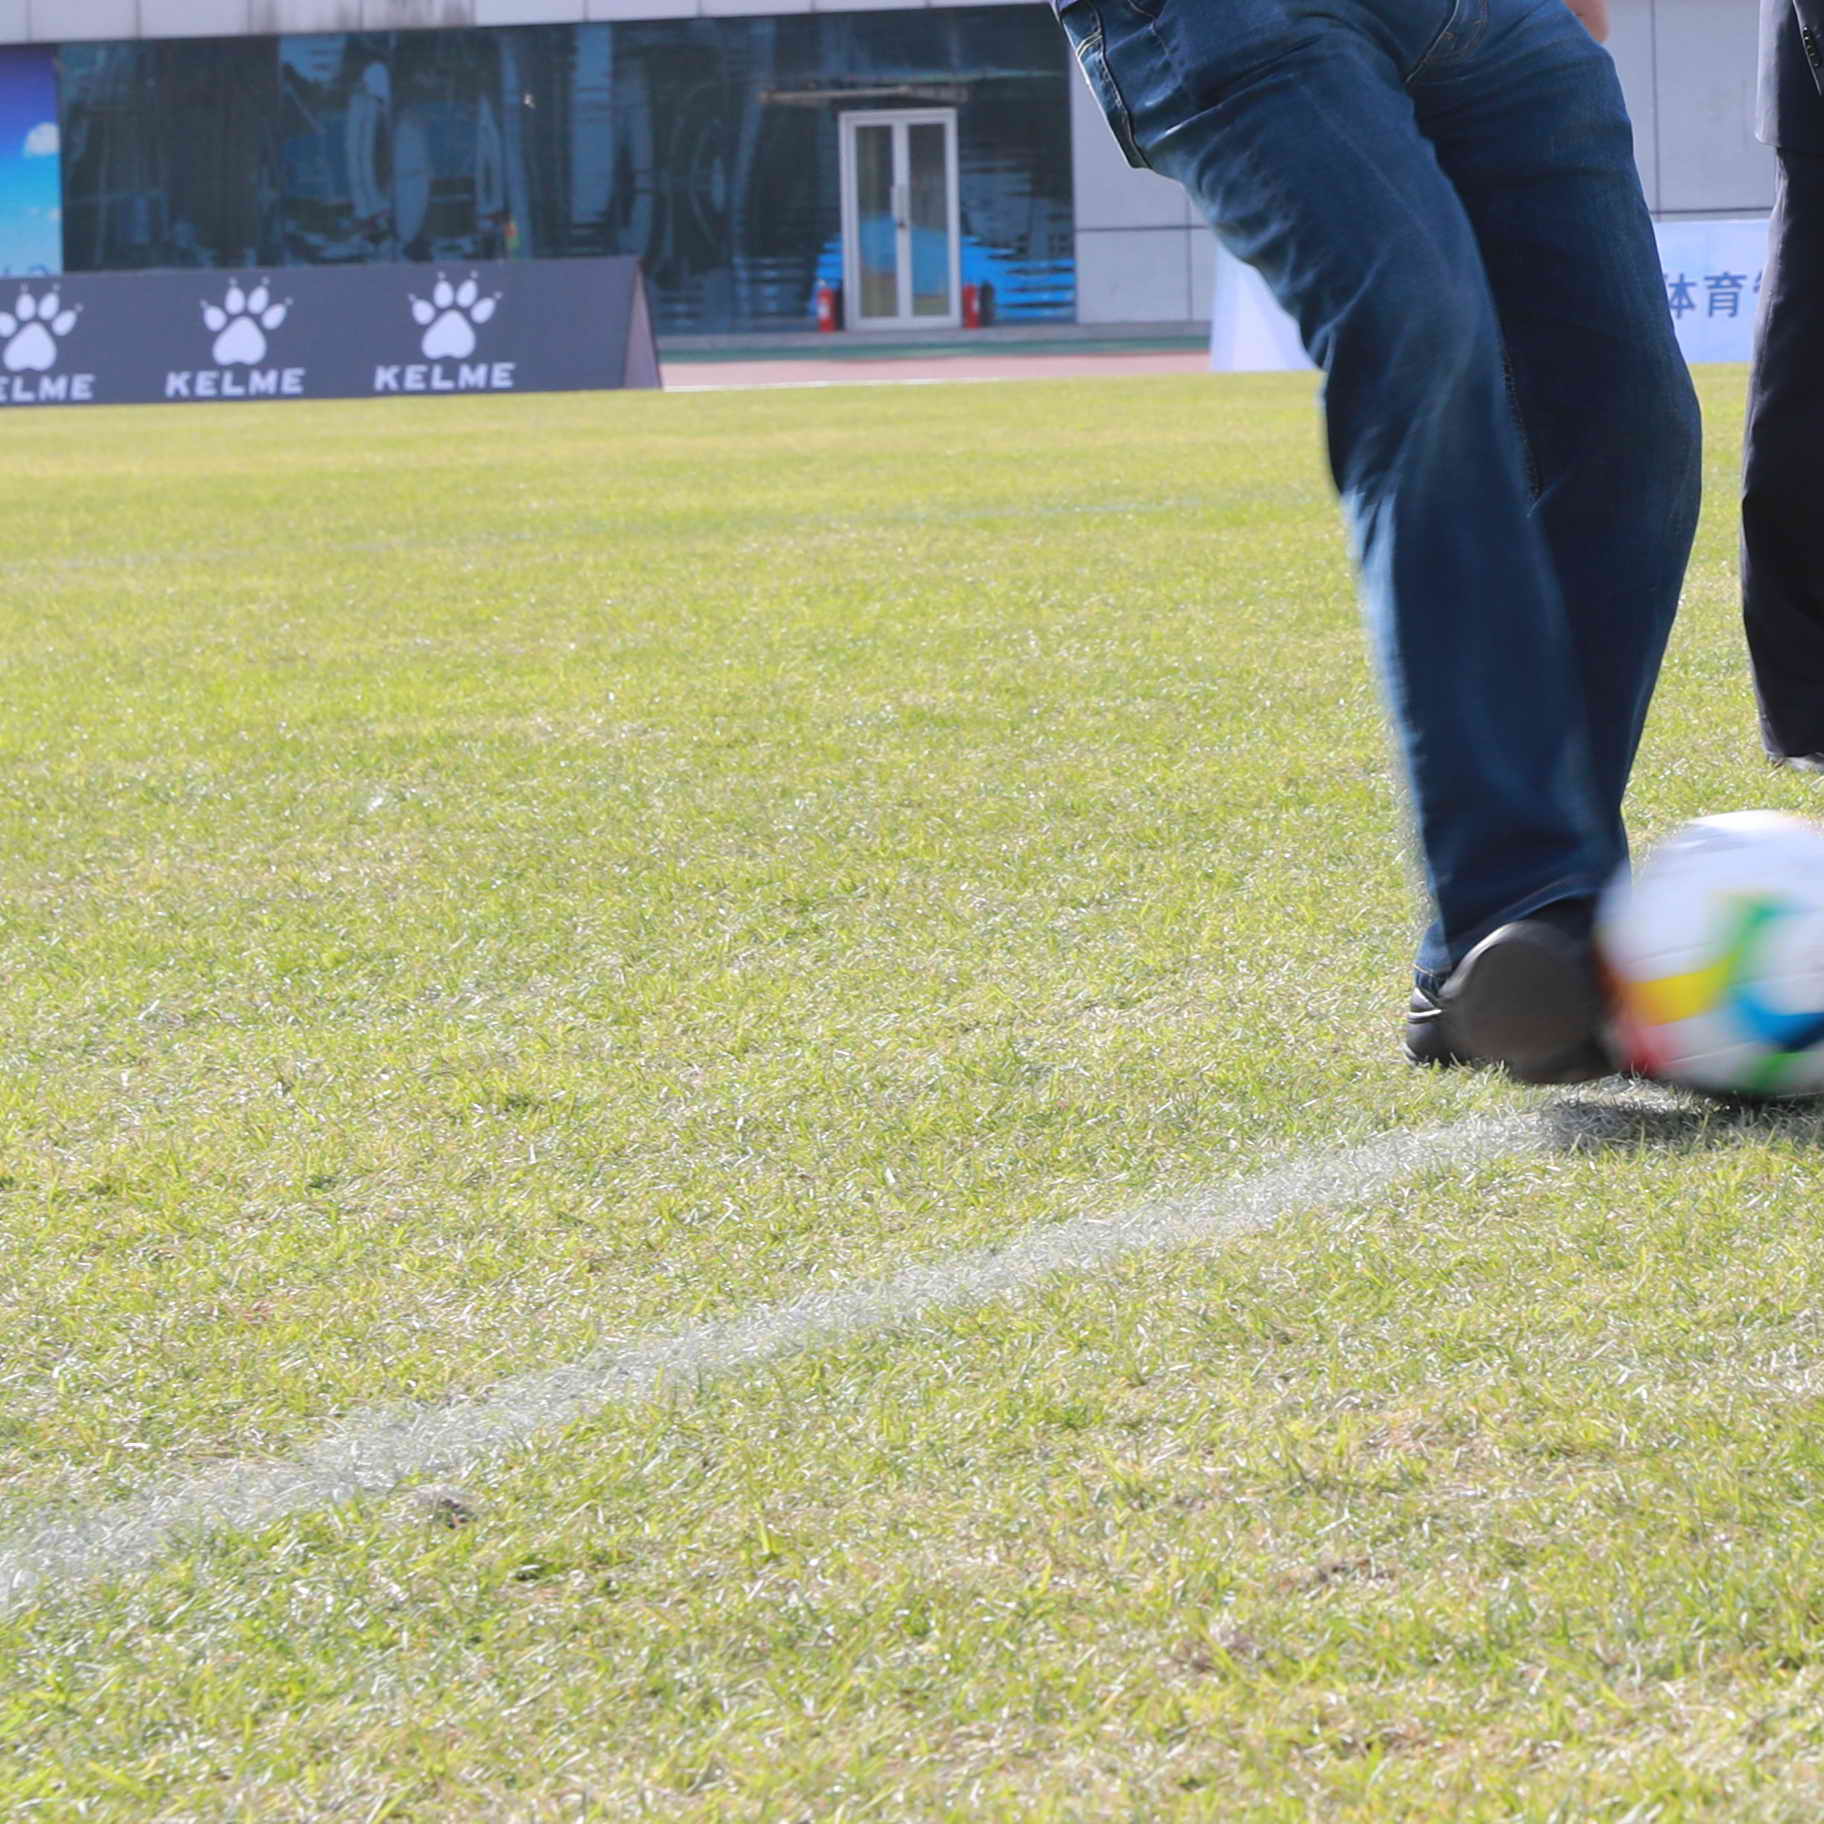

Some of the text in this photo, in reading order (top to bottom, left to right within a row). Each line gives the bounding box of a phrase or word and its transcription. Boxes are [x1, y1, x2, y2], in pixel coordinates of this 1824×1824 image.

[1668, 271, 1762, 320] 体育
[0, 373, 95, 402] LME
[165, 367, 306, 398] KELME
[373, 362, 516, 391] KELME
